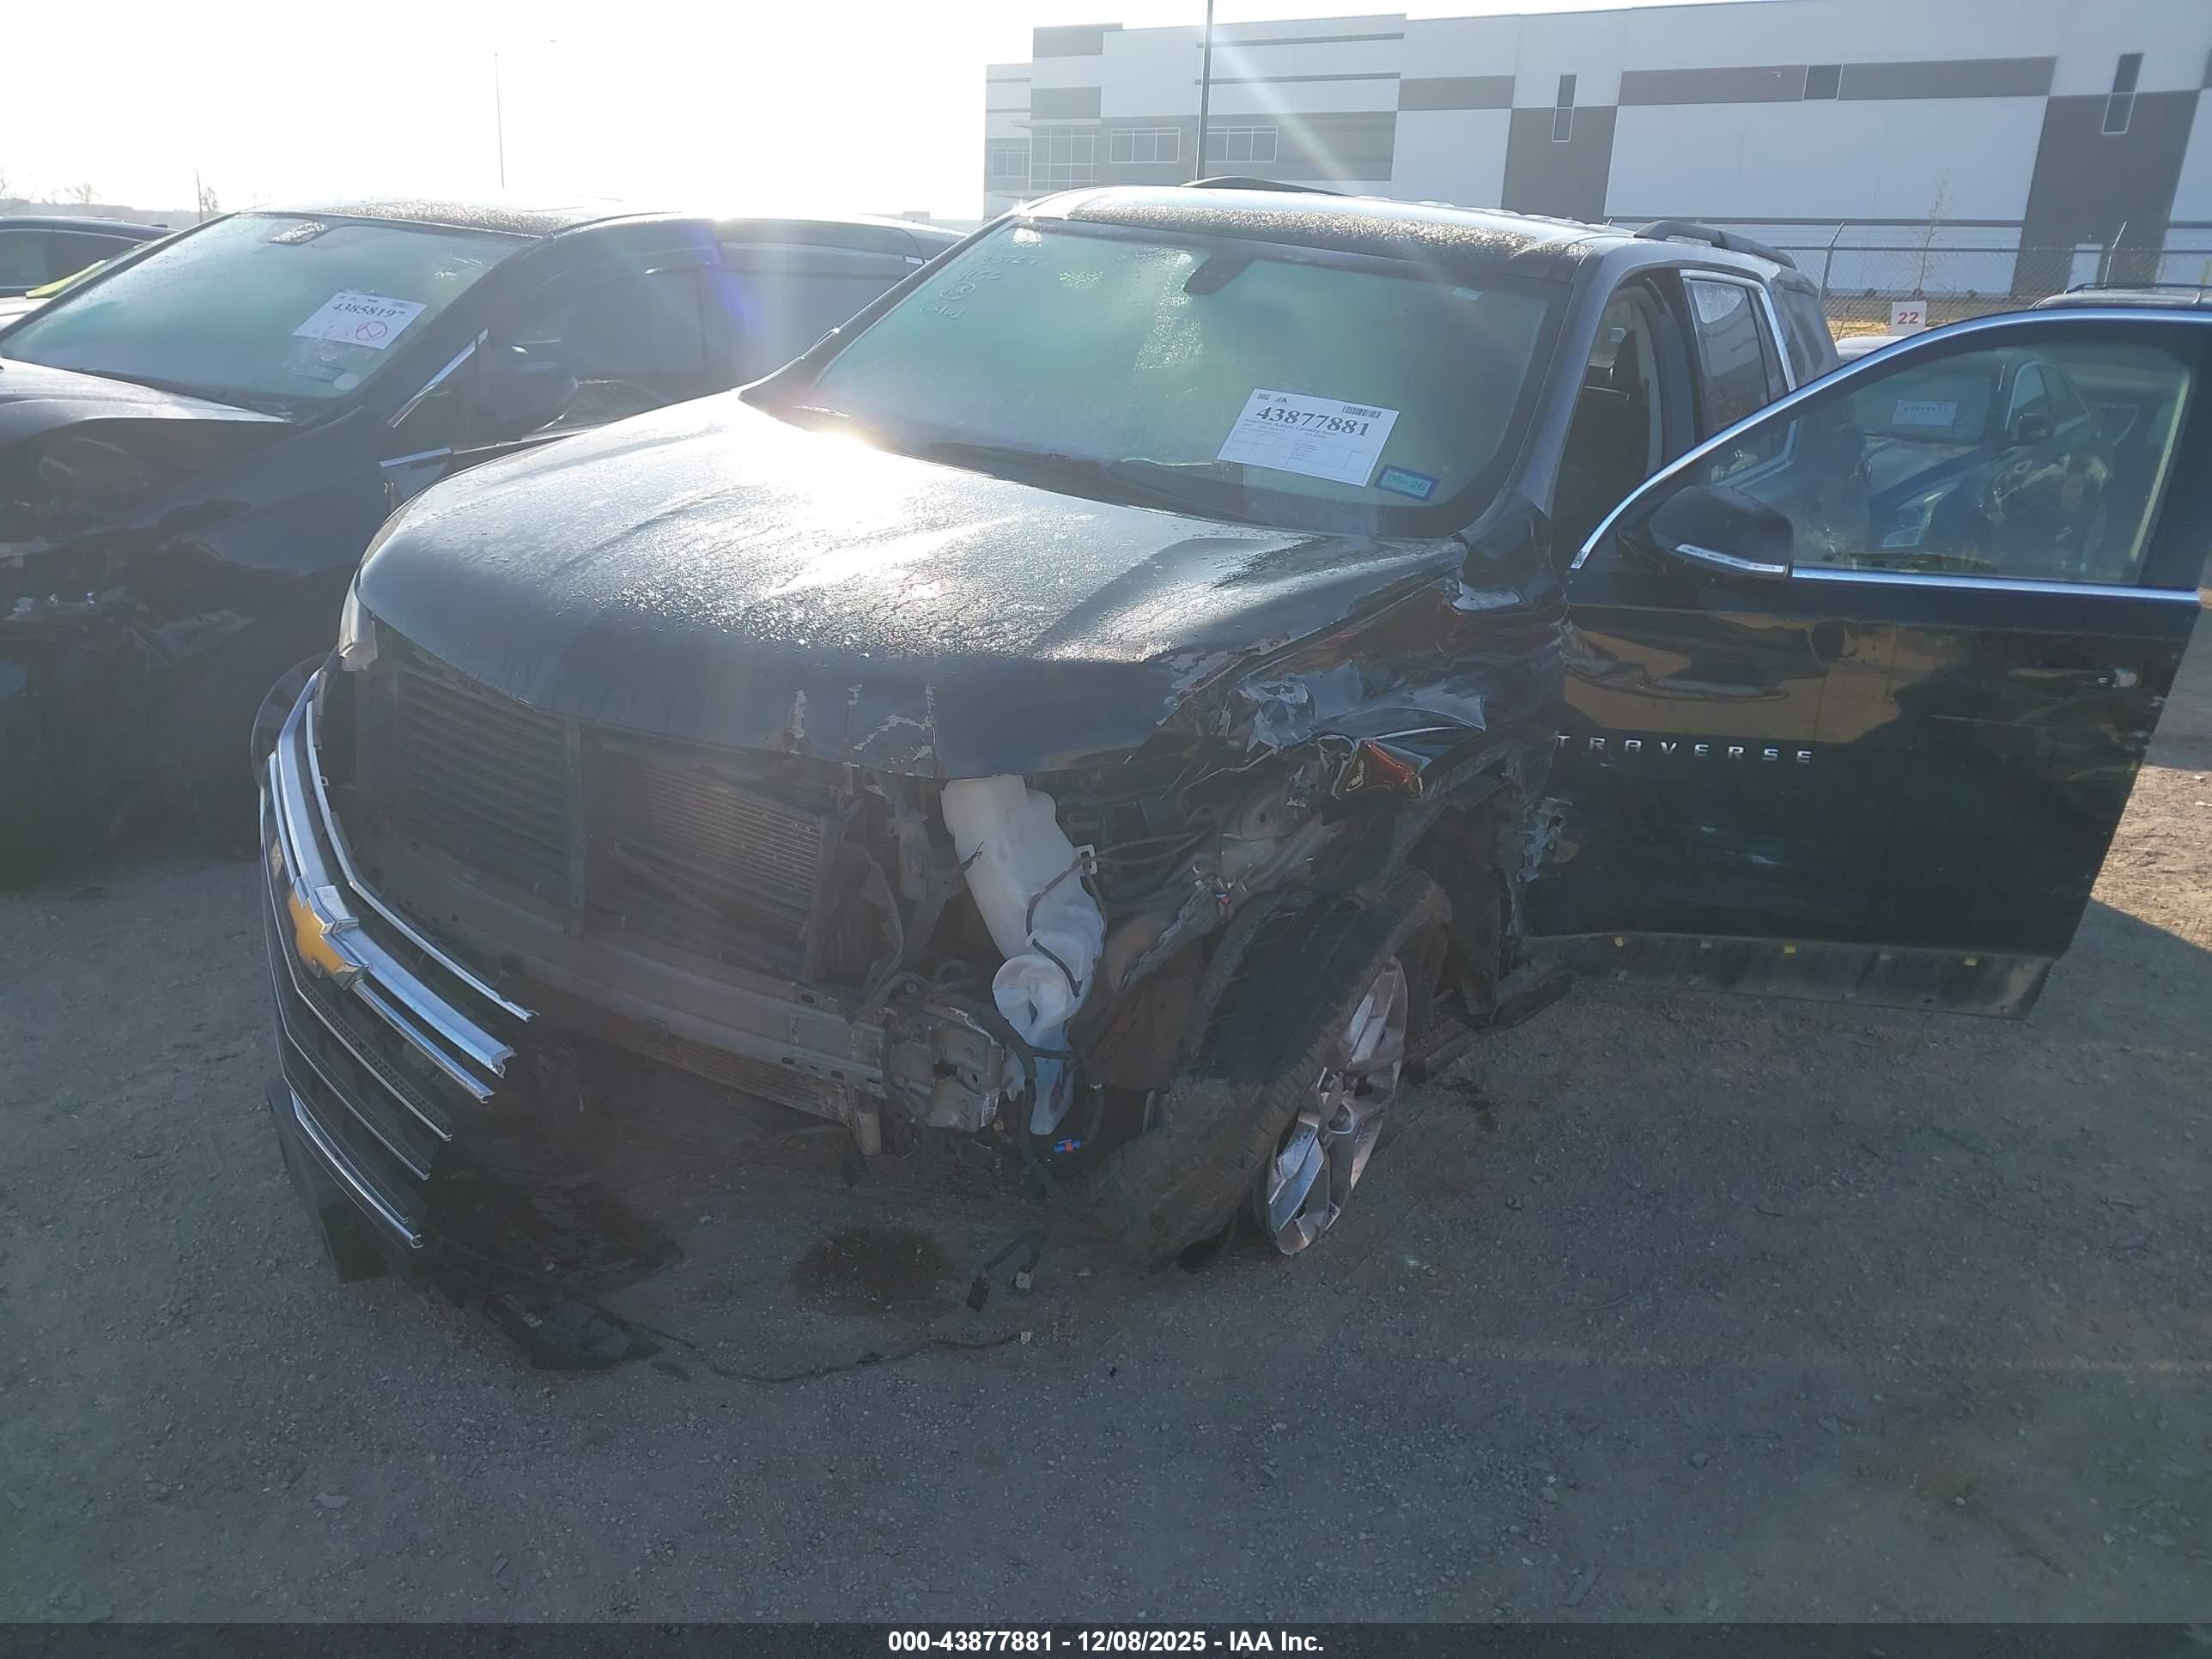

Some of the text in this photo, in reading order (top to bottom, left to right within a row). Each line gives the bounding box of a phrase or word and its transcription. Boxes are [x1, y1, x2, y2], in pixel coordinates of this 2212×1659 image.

[1898, 312, 1919, 325] 22
[1256, 406, 1370, 437] 43877881
[1555, 734, 1814, 763] TRAVERSE
